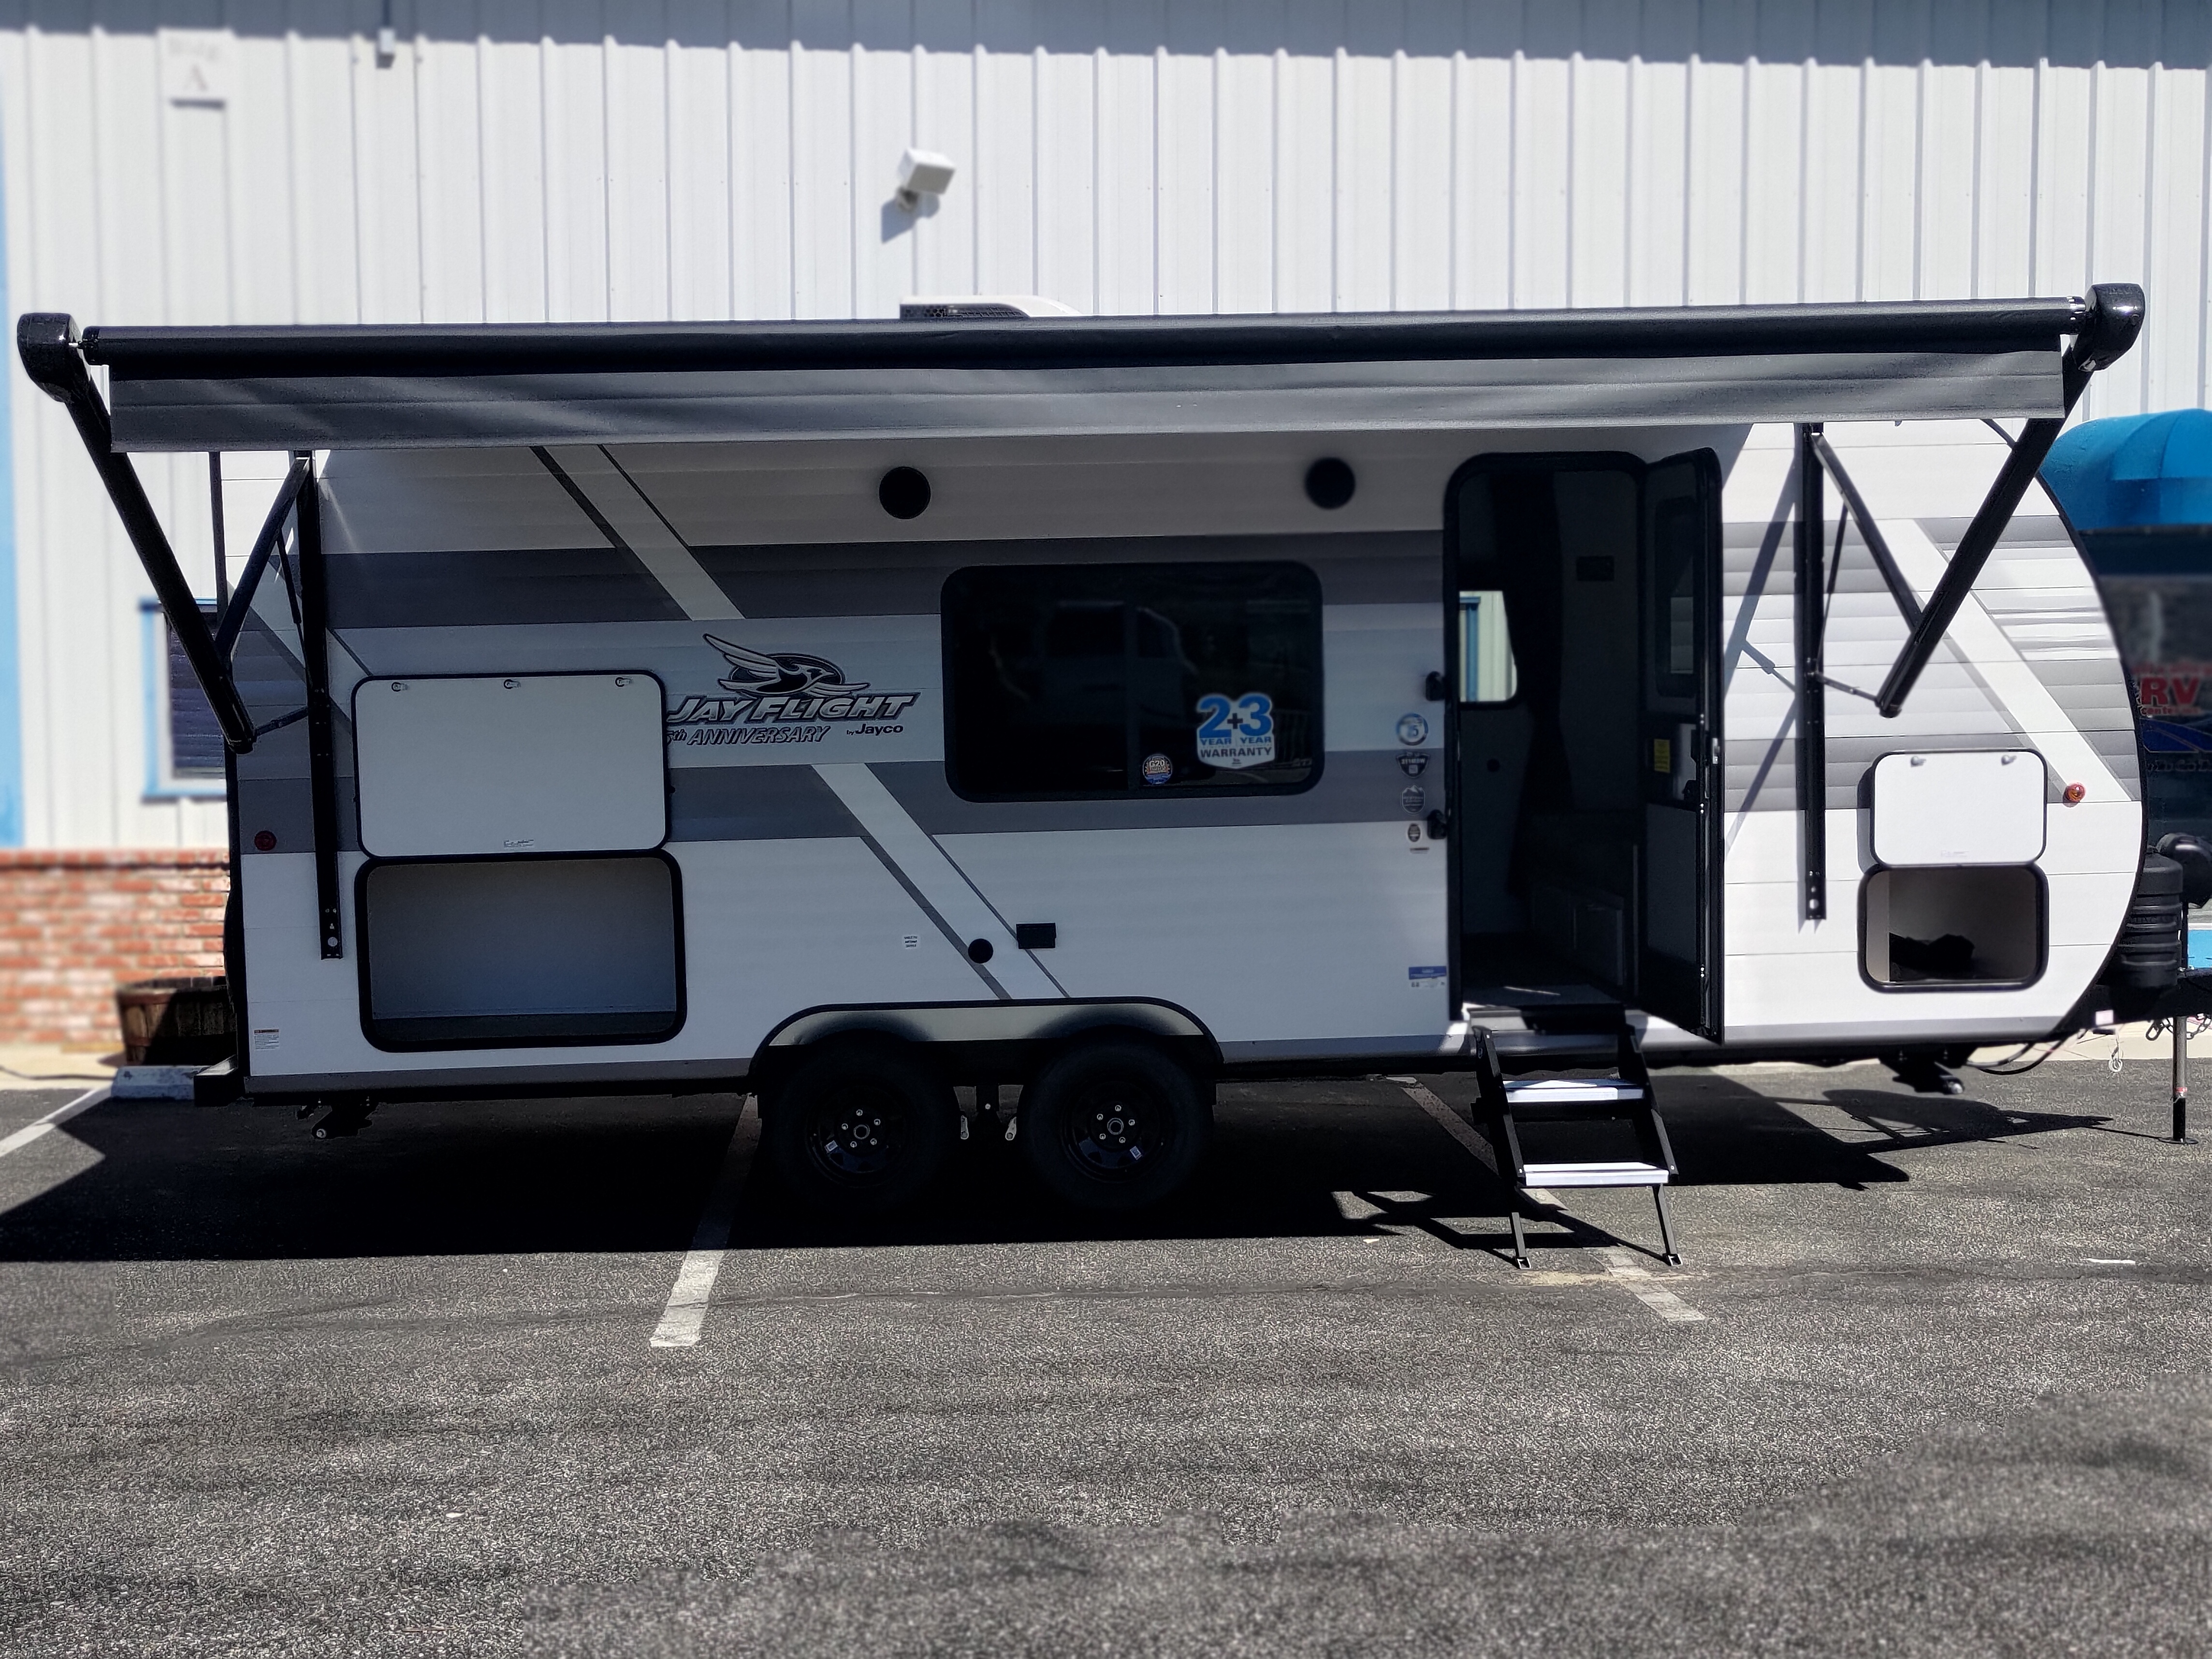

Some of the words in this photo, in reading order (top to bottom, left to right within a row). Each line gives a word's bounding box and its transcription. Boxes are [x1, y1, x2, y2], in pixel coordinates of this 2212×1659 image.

[2141, 676, 2199, 705] RV
[667, 696, 754, 724] JAY
[749, 693, 920, 724] FLIGHT
[687, 726, 830, 745] ANNIVERSARY
[855, 723, 903, 736] Jayco
[1200, 747, 1272, 758] WARRANTY
